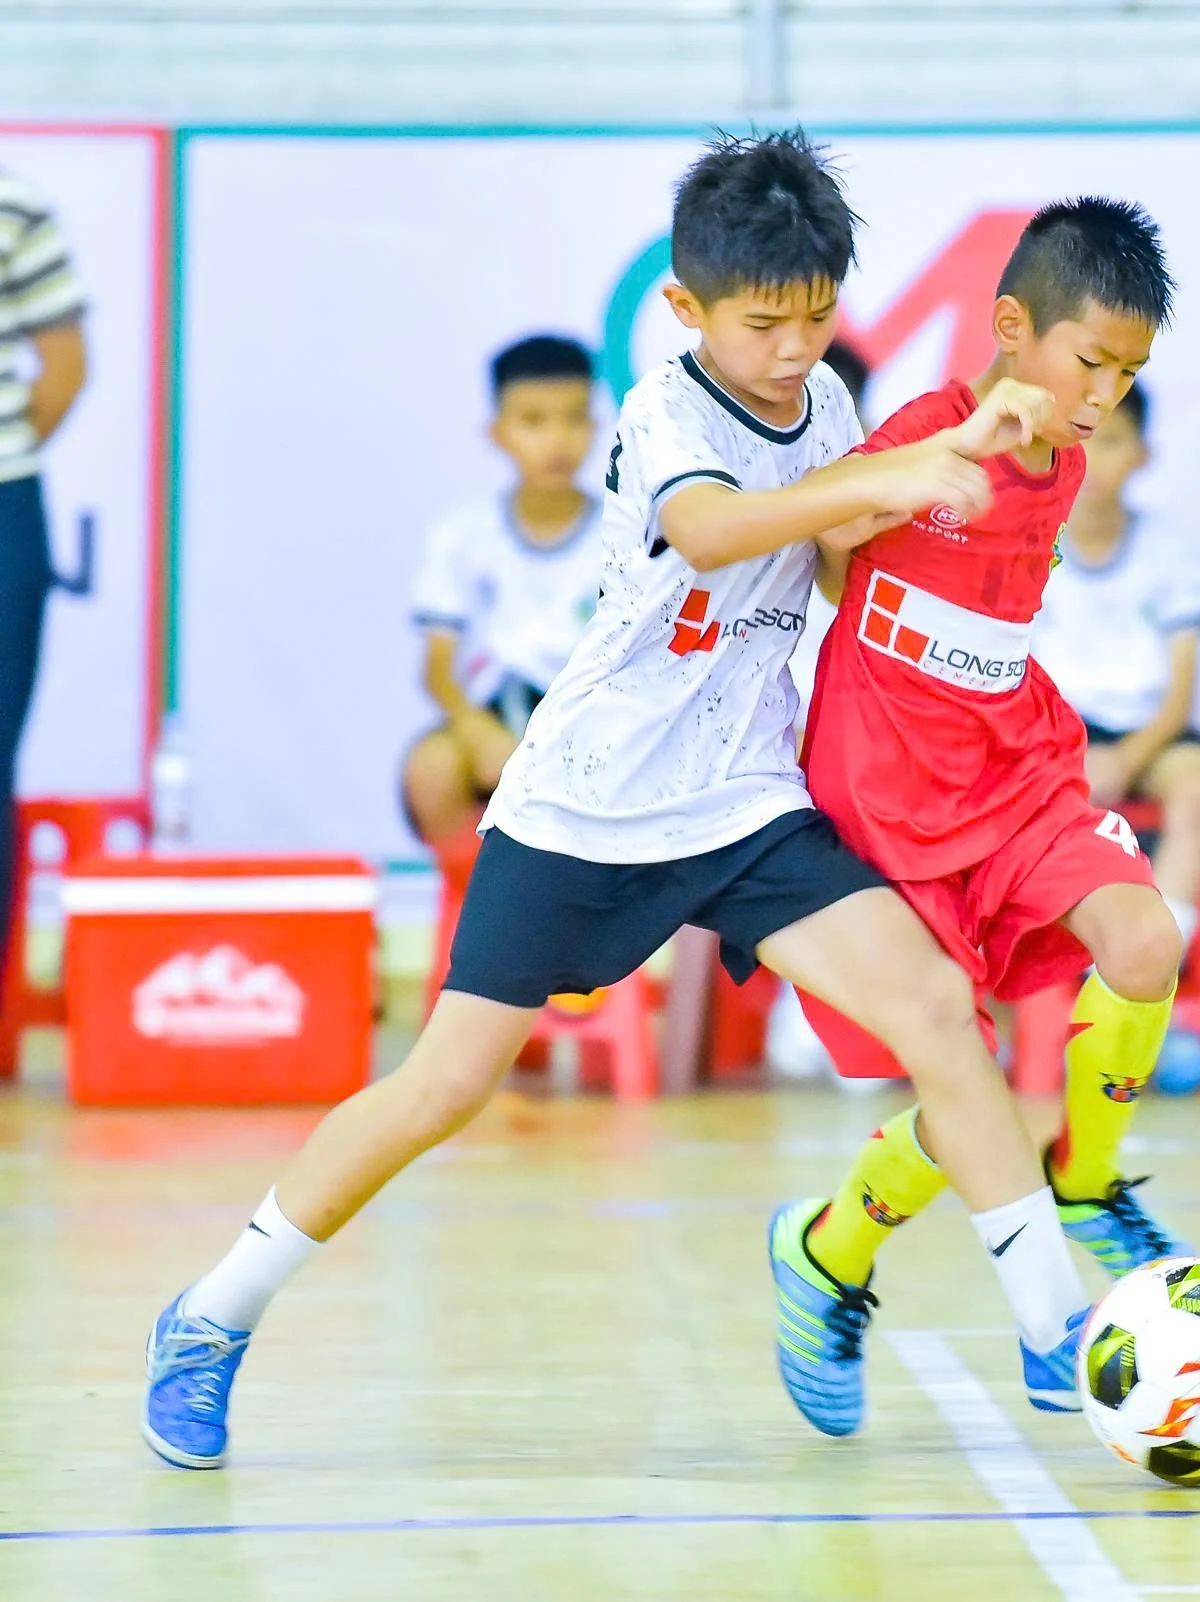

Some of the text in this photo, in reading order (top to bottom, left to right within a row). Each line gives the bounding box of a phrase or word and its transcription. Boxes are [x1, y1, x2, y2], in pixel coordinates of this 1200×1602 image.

[927, 526, 968, 544] SPORT
[928, 640, 1004, 678] LONG
[1093, 809, 1140, 859] 4
